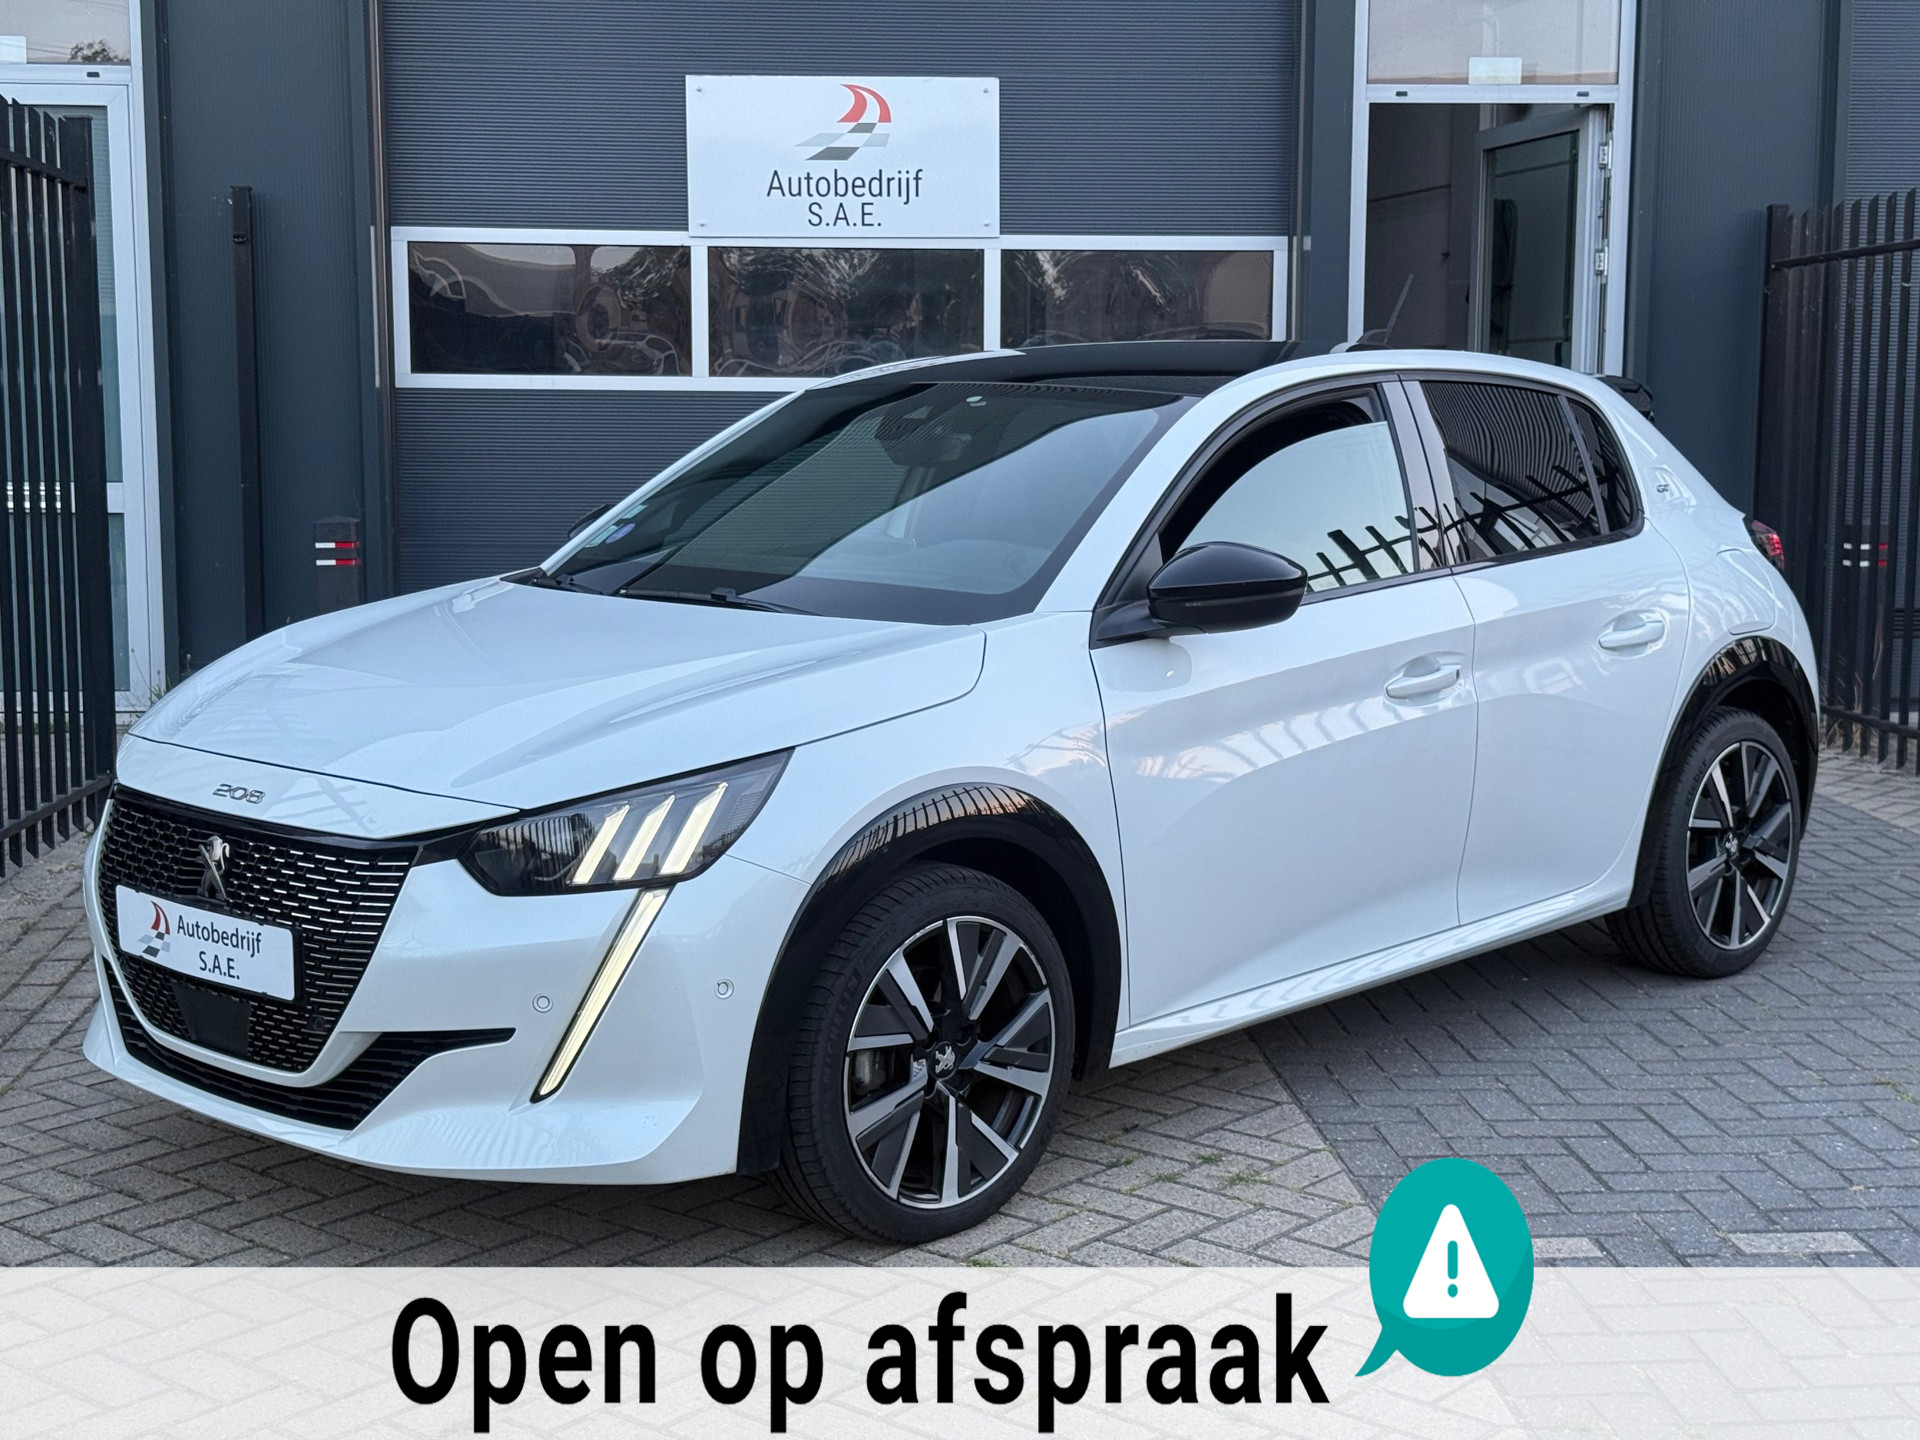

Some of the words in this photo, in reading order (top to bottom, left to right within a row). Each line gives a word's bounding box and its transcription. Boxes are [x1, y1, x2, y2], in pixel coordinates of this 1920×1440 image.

[767, 168, 923, 206] Autobedrijf
[808, 202, 882, 227] S.A.E.
[212, 783, 266, 804] 208
[177, 914, 262, 958] Autobedrijf
[199, 951, 240, 980] S.A.E.
